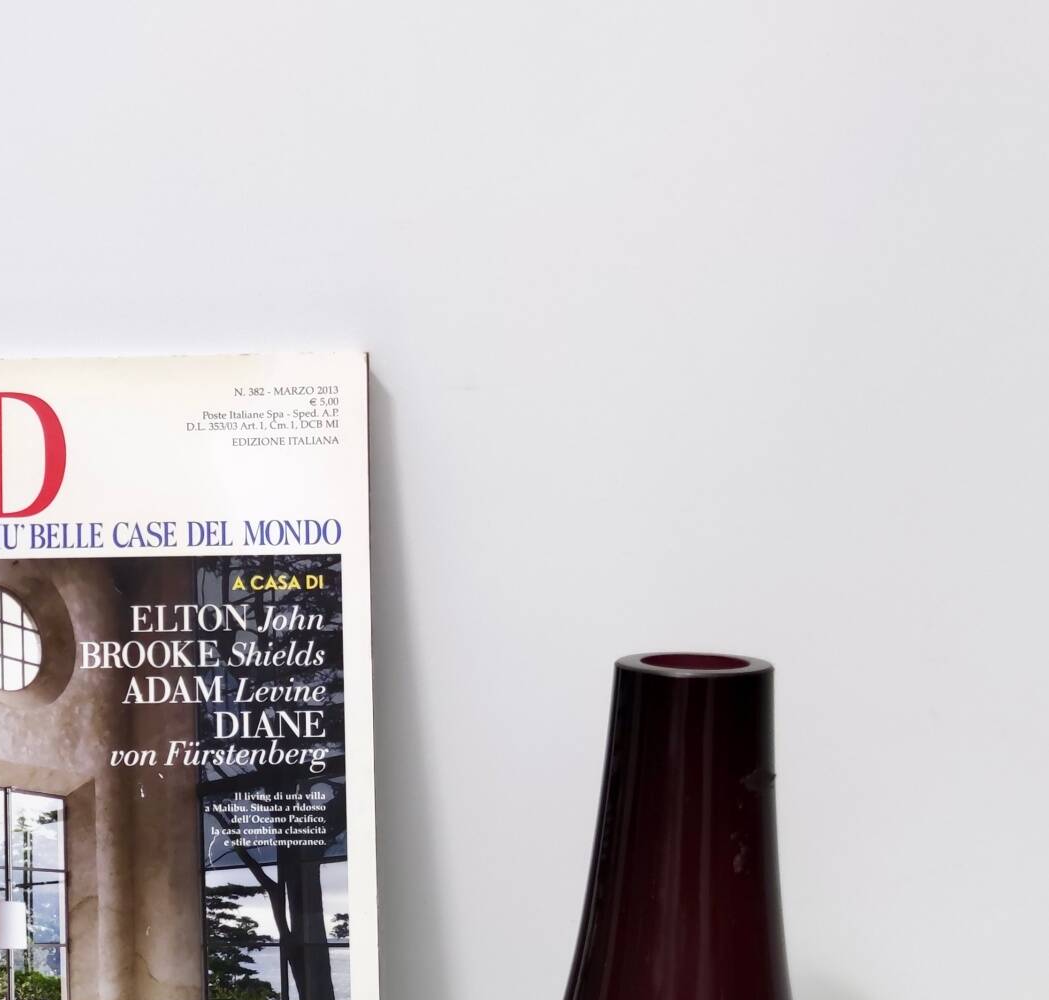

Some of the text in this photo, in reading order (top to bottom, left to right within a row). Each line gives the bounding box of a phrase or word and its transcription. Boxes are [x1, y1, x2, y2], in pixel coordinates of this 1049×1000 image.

[234, 388, 245, 397] N.
[249, 388, 265, 396] 382
[274, 387, 314, 396] MARZO
[317, 386, 339, 395] 2013
[310, 398, 339, 407] € 5,00
[203, 411, 226, 420] Poste
[230, 410, 264, 419] Italiane
[267, 410, 284, 422] Spa
[293, 409, 318, 421] Sped.
[322, 409, 339, 418] A.P.
[187, 422, 205, 431] D.L.
[209, 422, 238, 431] 353/03
[301, 420, 322, 429] DCB
[326, 420, 339, 428] MI
[232, 436, 339, 446] EDIZIONE ITALIANA
[30, 523, 103, 549] BELLE
[112, 522, 177, 548] CASE
[188, 521, 233, 547] DEL
[244, 519, 342, 546] MONDO
[232, 576, 324, 590] A CASA DI
[130, 604, 324, 633] ELTON John
[80, 640, 325, 669] BROOKE Shields
[122, 676, 326, 704] ADAM Levine
[214, 710, 326, 739] DIANE
[110, 740, 329, 773] von Fürstenberg
[245, 792, 271, 803] living
[274, 792, 283, 800] di
[305, 792, 326, 800] villa
[213, 804, 248, 812] Malibu.
[251, 804, 283, 812] Situata
[293, 804, 326, 812] ridosso
[289, 815, 326, 824] Pacifico,
[212, 827, 220, 835] la
[244, 827, 283, 835] combina
[285, 826, 326, 835] classicità
[232, 838, 251, 846] stile
[253, 839, 326, 848] contemporaneo.
